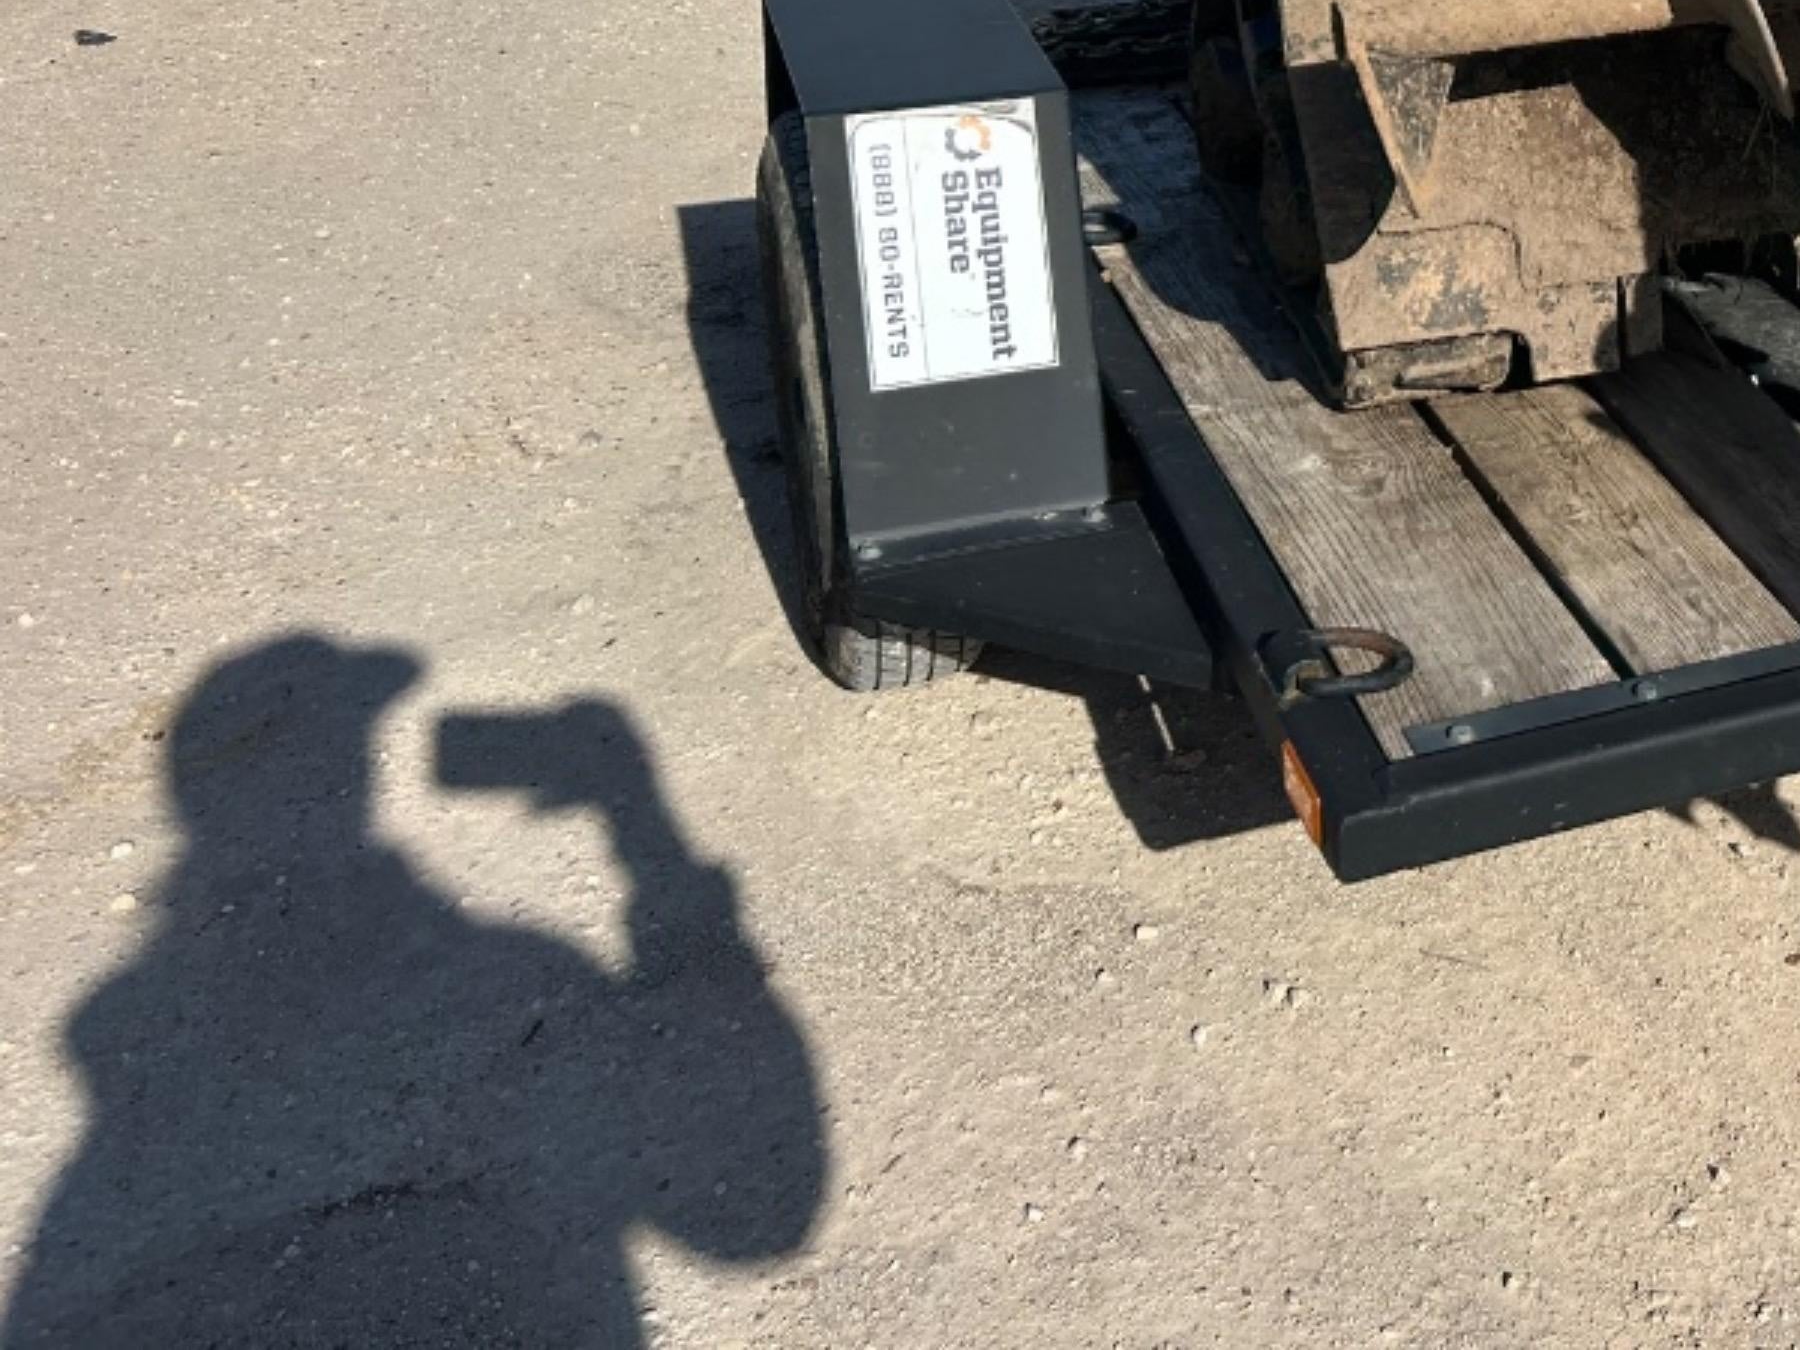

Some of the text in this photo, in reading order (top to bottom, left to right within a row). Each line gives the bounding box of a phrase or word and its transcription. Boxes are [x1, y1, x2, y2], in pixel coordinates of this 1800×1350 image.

[868, 143, 910, 358] (888) 80-RENTS
[941, 169, 970, 274] Share
[971, 166, 1018, 361] Equipment
